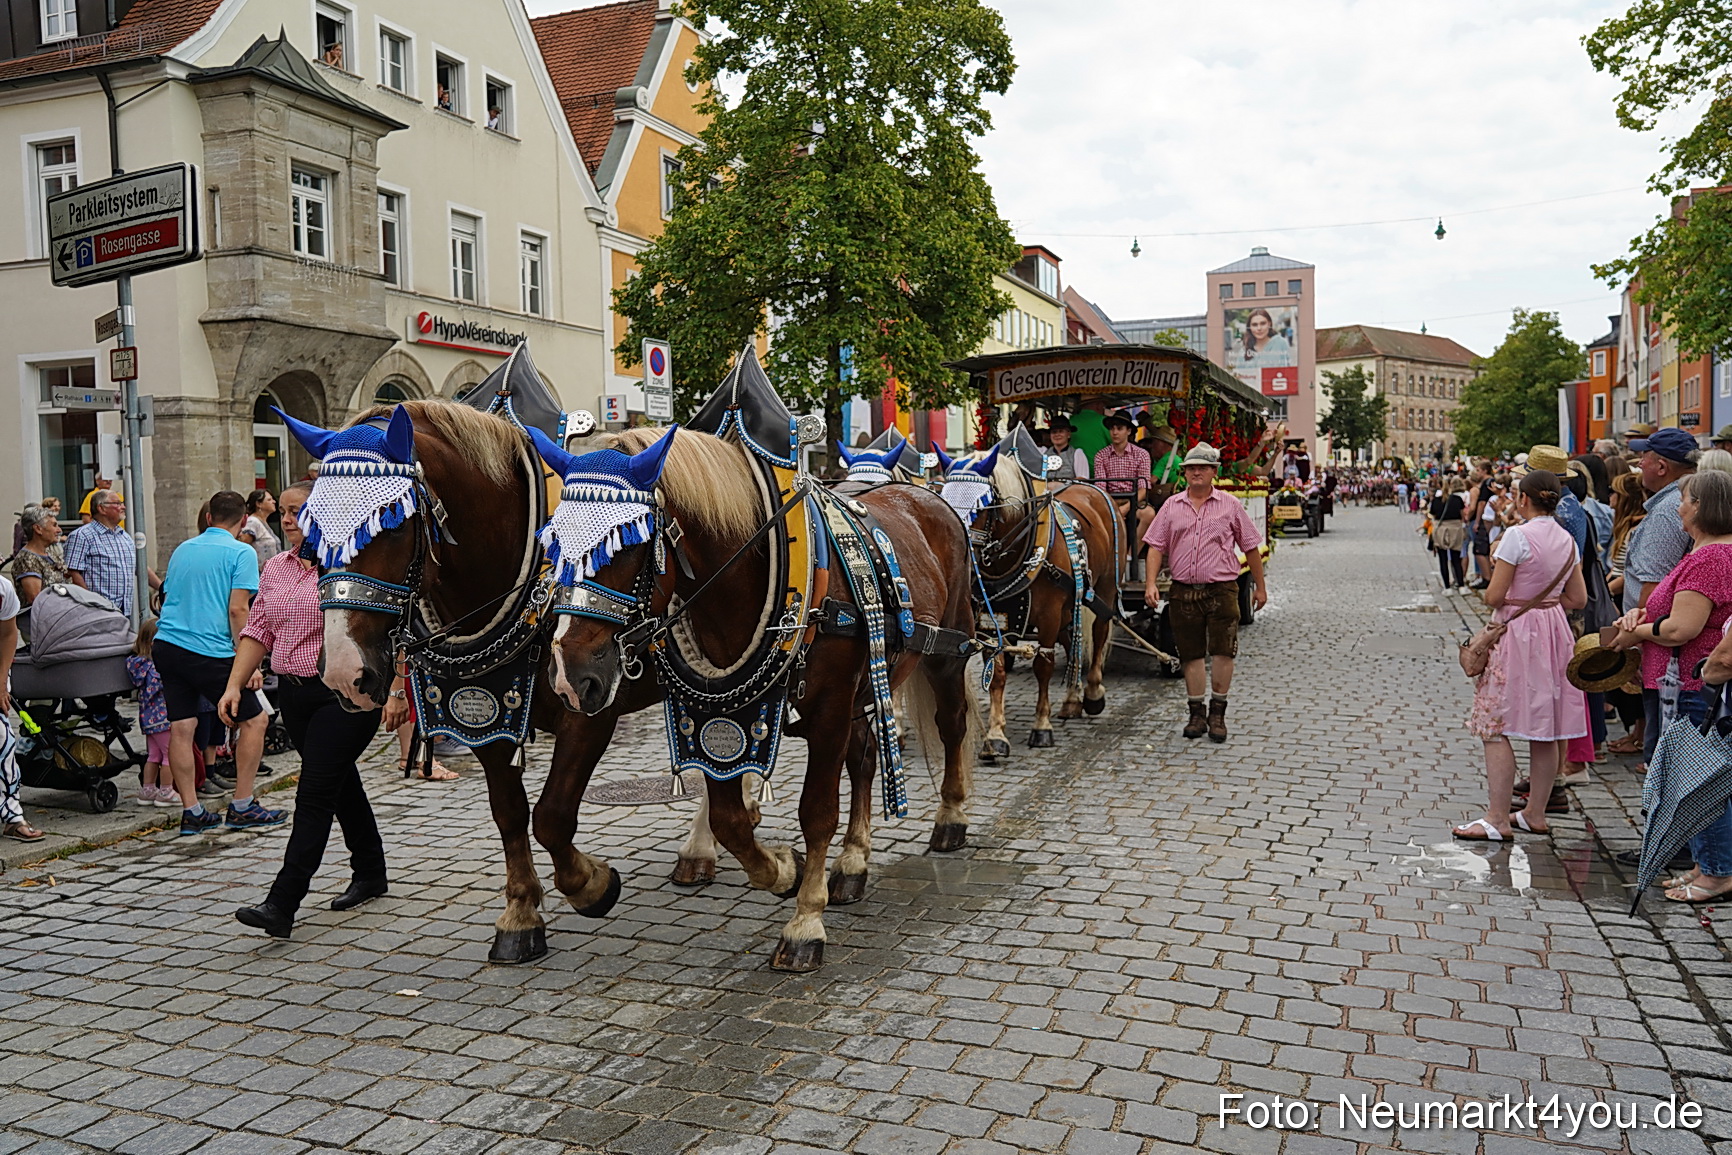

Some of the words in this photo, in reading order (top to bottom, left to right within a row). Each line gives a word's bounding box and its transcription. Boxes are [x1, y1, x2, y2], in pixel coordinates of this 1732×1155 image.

[69, 187, 158, 226] Parkleitsystem
[101, 230, 161, 256] Rosengasse
[434, 315, 528, 347] HypoVereinsbank
[652, 377, 665, 386] ZONE
[999, 361, 1118, 397] Gesangverein
[1122, 360, 1180, 391] Pölling
